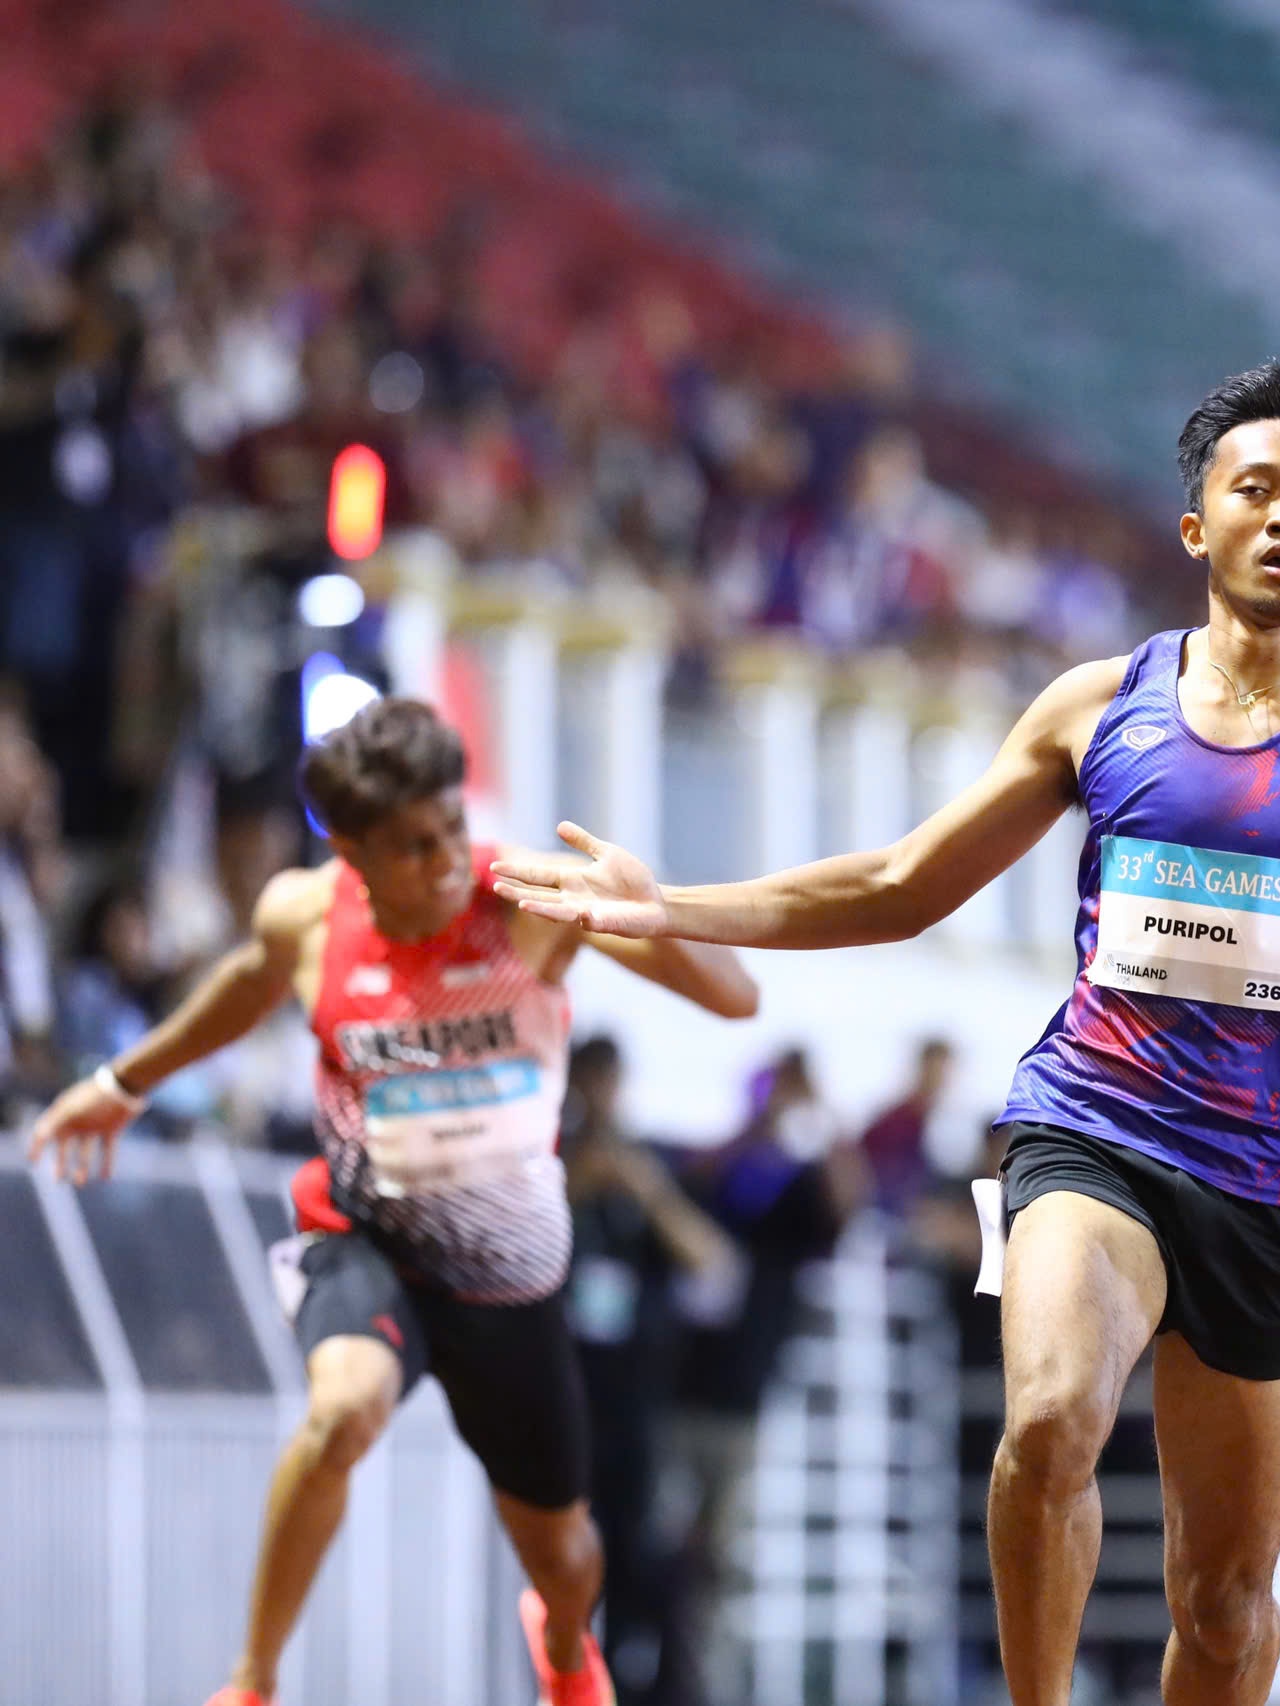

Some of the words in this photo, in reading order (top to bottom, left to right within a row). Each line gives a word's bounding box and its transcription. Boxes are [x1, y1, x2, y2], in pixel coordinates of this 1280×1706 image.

[1154, 859, 1197, 889] SEA
[1143, 915, 1238, 945] PURIPOL
[1116, 962, 1168, 981] THAILAND
